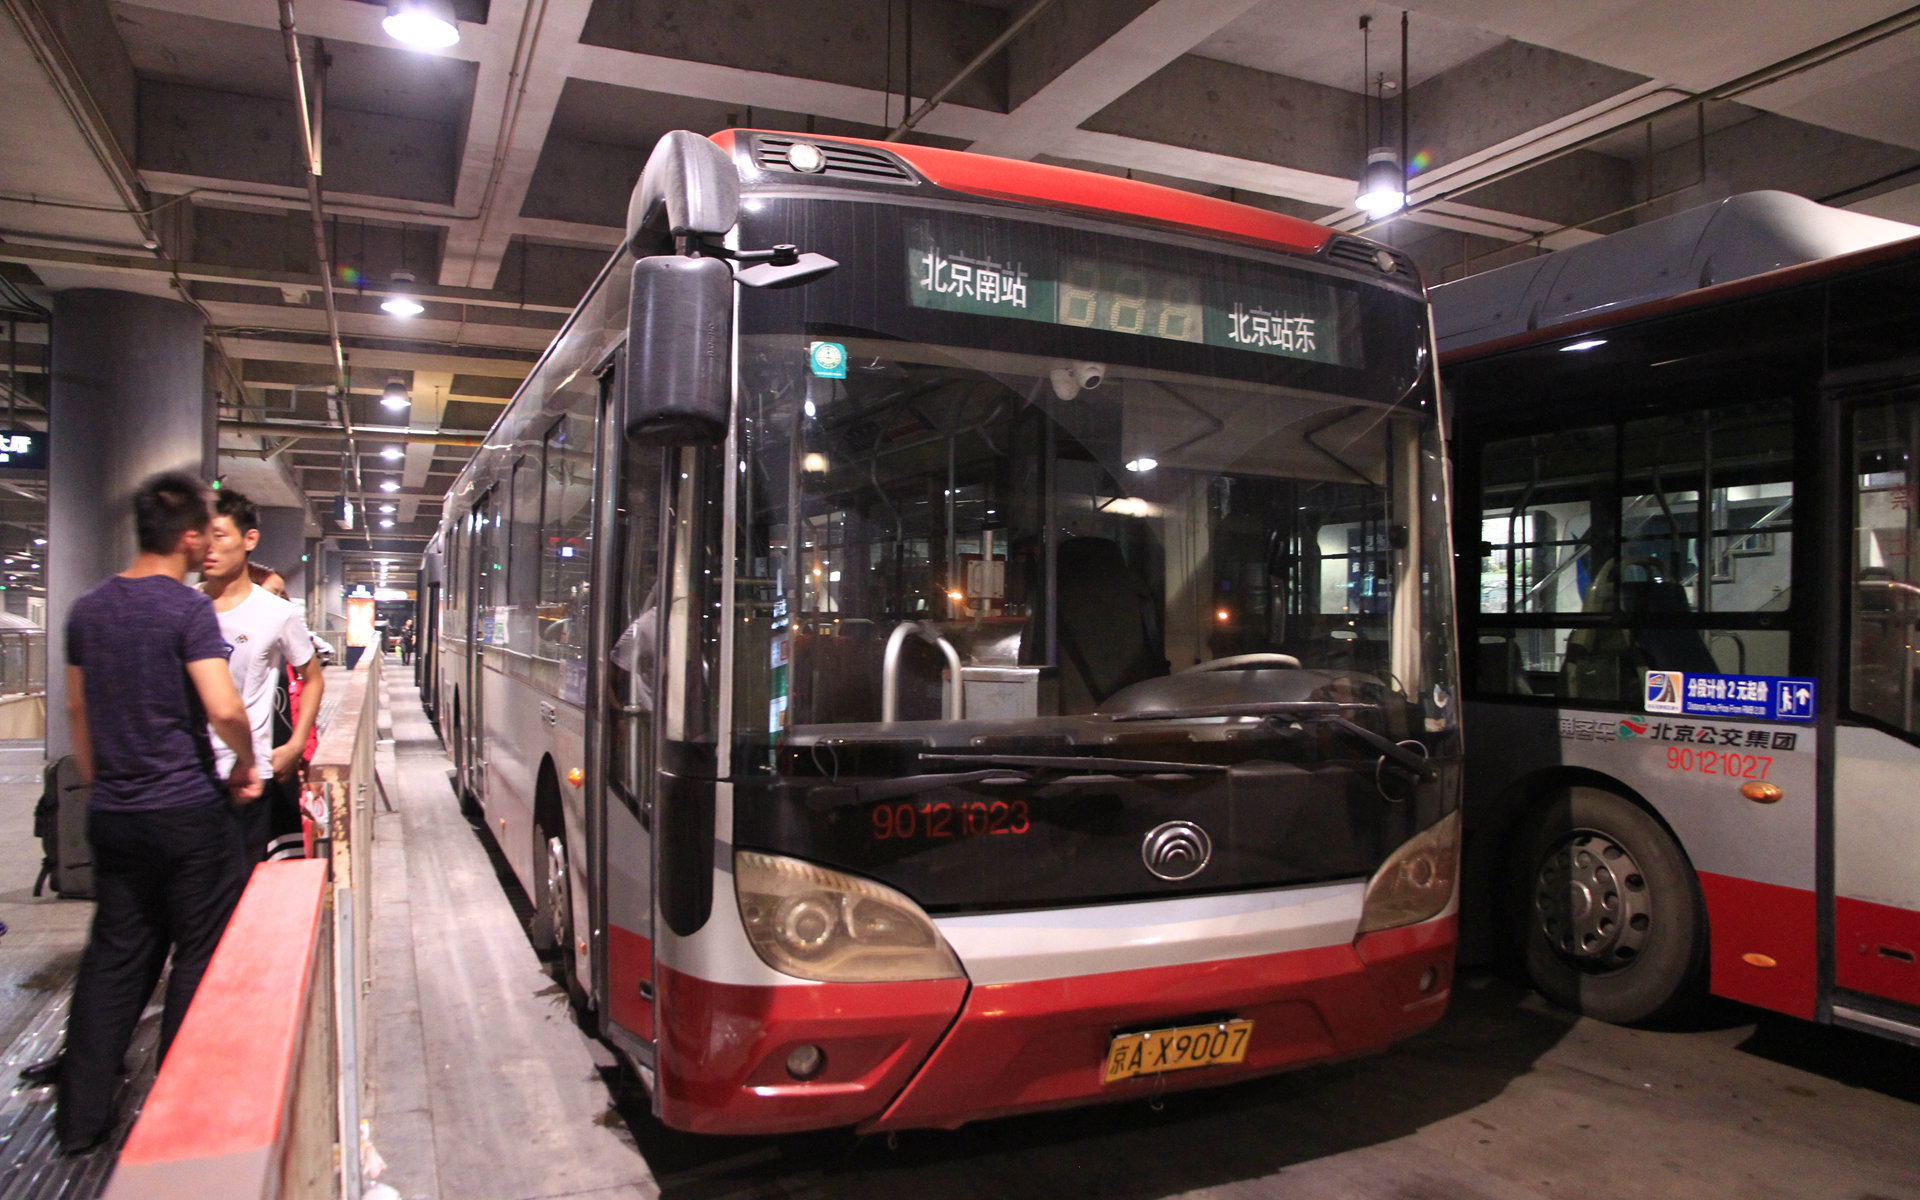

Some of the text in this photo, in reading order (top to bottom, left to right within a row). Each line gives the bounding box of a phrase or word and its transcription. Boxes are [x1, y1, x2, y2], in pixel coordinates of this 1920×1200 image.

[921, 246, 1028, 308] 北京南站
[1228, 302, 1316, 353] 北京站东
[1651, 722, 1798, 751] 北京公交集团
[1666, 746, 1774, 780] 90121027
[872, 800, 1031, 840] 90121023
